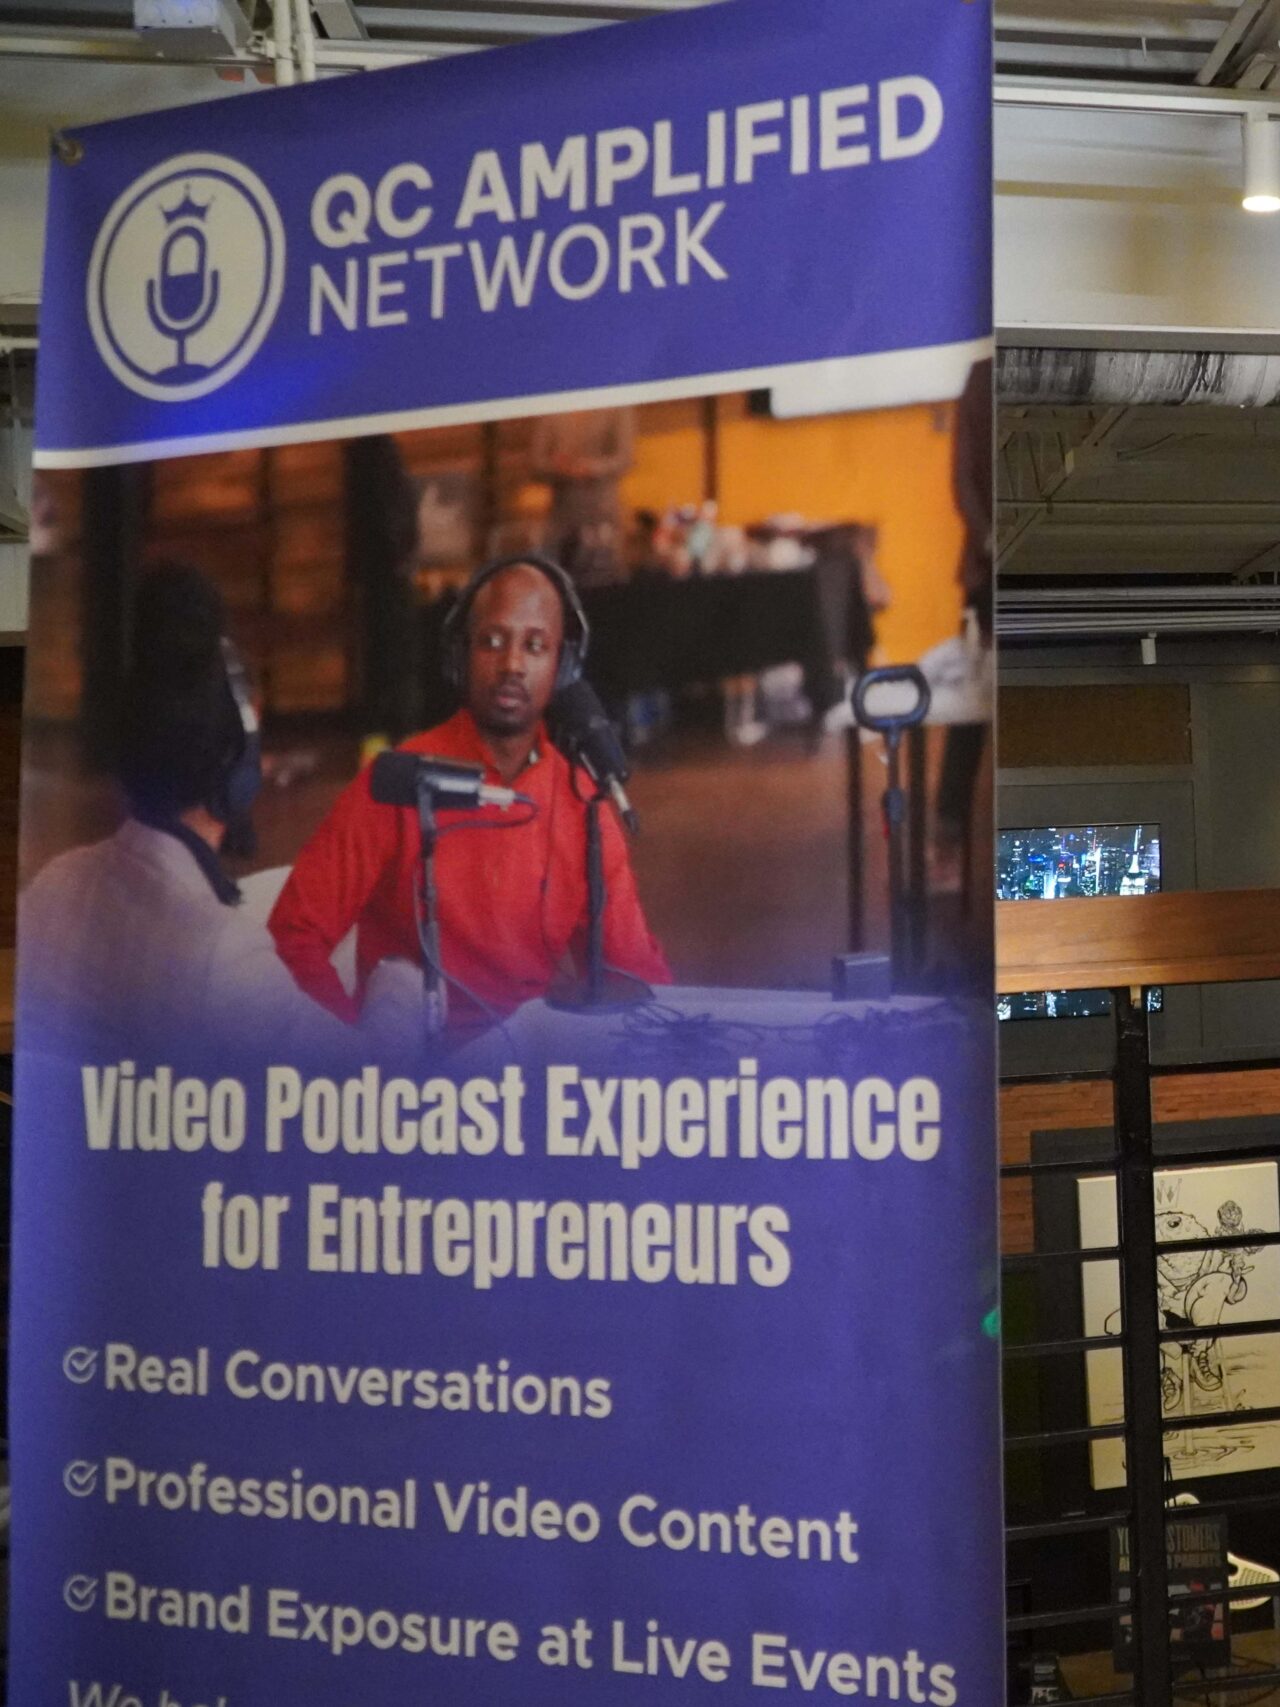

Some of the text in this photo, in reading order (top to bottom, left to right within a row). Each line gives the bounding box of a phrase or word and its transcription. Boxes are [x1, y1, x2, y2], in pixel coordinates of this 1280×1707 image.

[310, 74, 944, 249] QC AMPLIFIED
[309, 201, 728, 336] NETWORK
[81, 1058, 943, 1170] Video Podcast Experience
[200, 1181, 793, 1290] for Entrepreneurs
[104, 1343, 613, 1419] Real Conversations
[105, 1457, 860, 1564] Professional Video Content
[105, 1572, 959, 1706] Brand Exposure at Live Events
